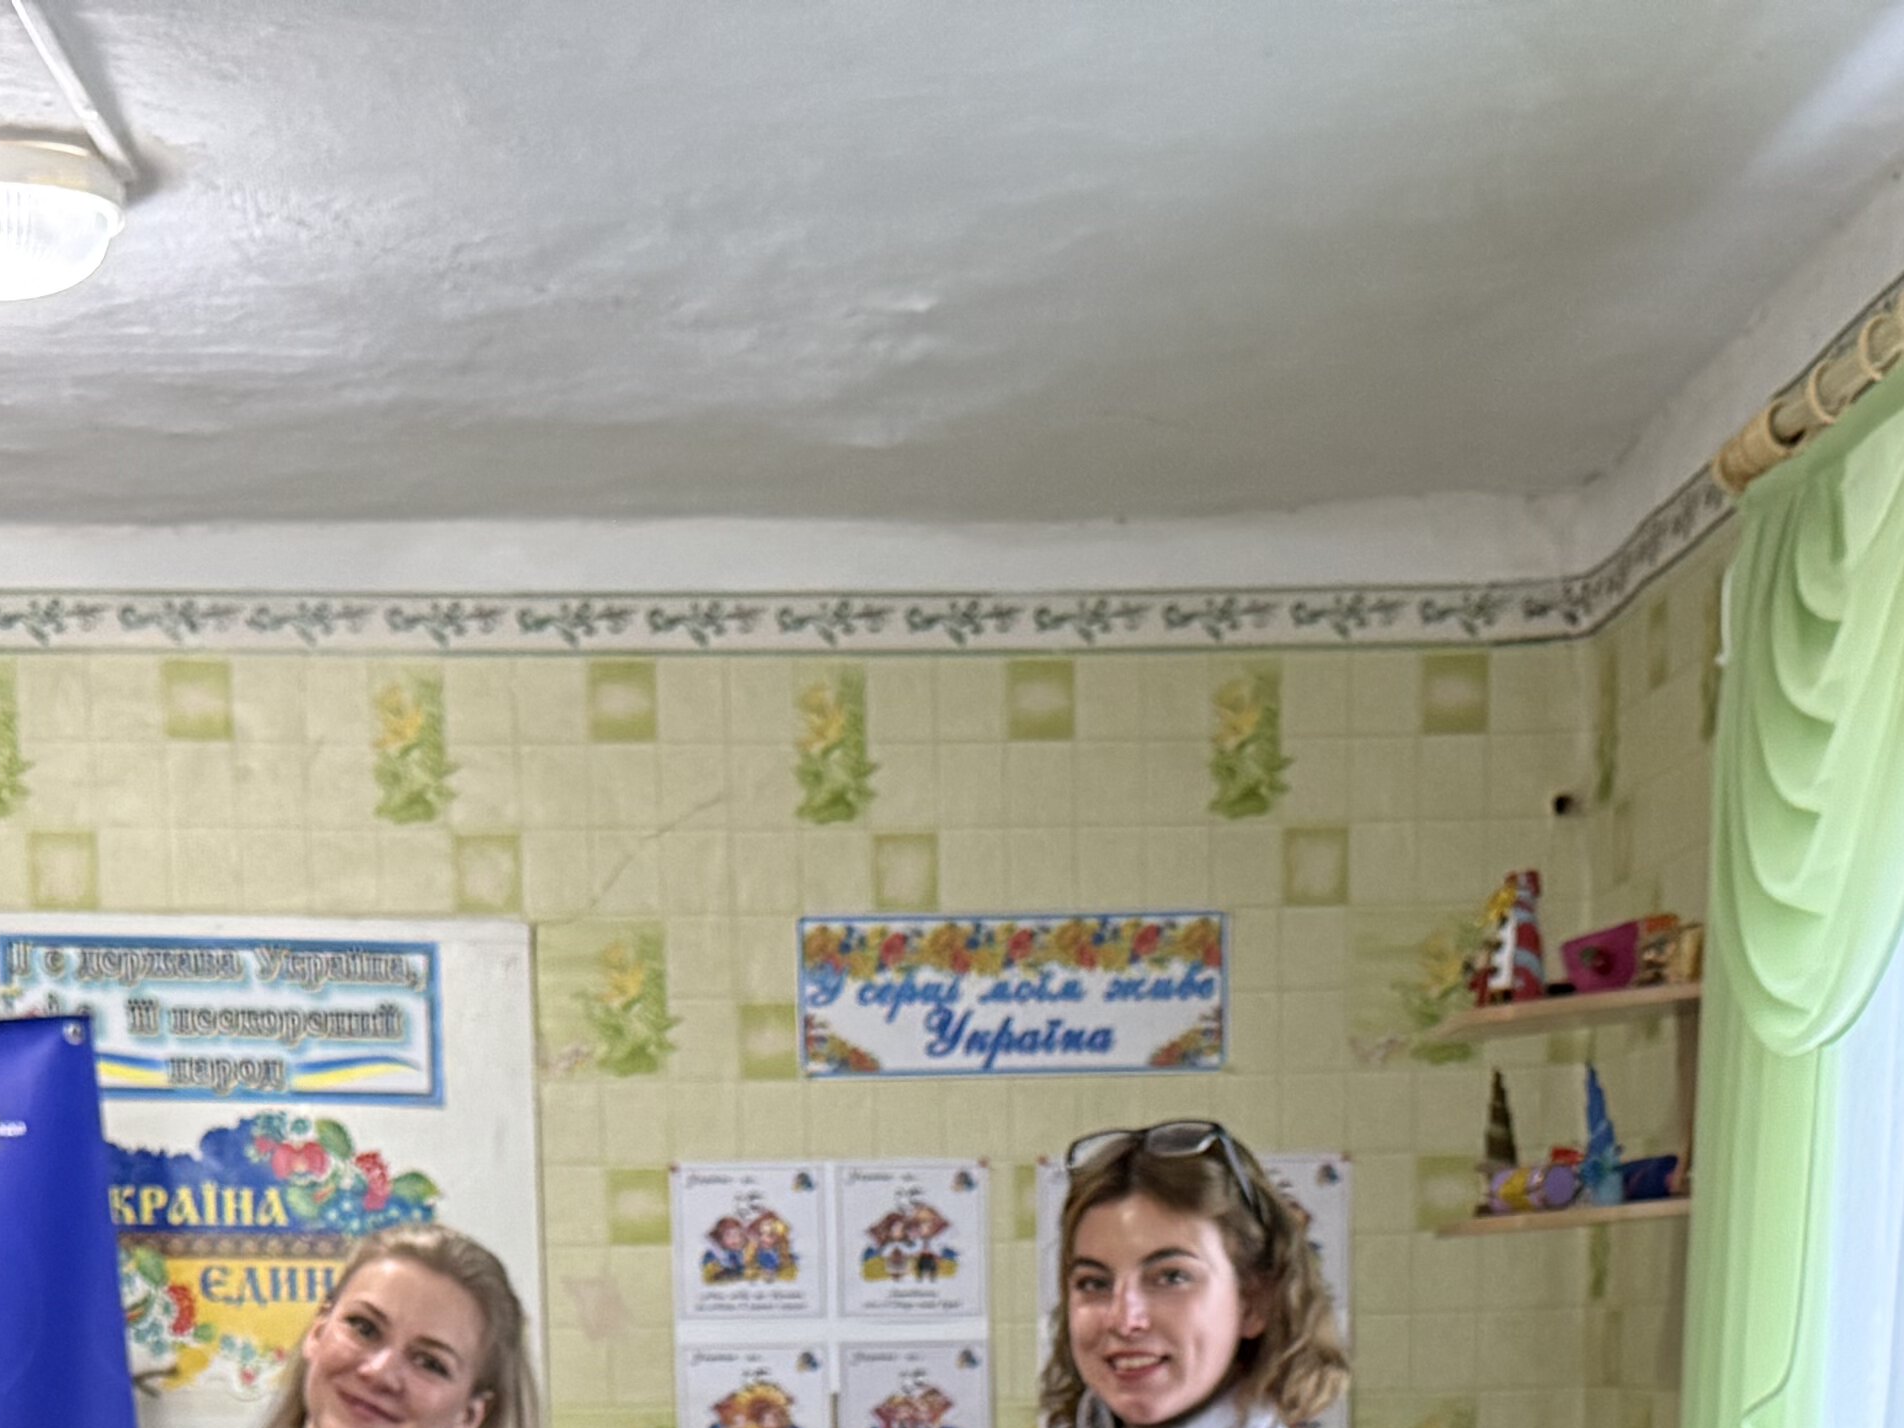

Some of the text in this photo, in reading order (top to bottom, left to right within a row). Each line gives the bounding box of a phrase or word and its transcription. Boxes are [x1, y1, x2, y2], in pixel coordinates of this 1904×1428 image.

[924, 1005, 1116, 1071] Україна
[166, 1055, 286, 1096] народ
[108, 1178, 290, 1227] КРАЇНА
[199, 1264, 334, 1309] ЄДИН
